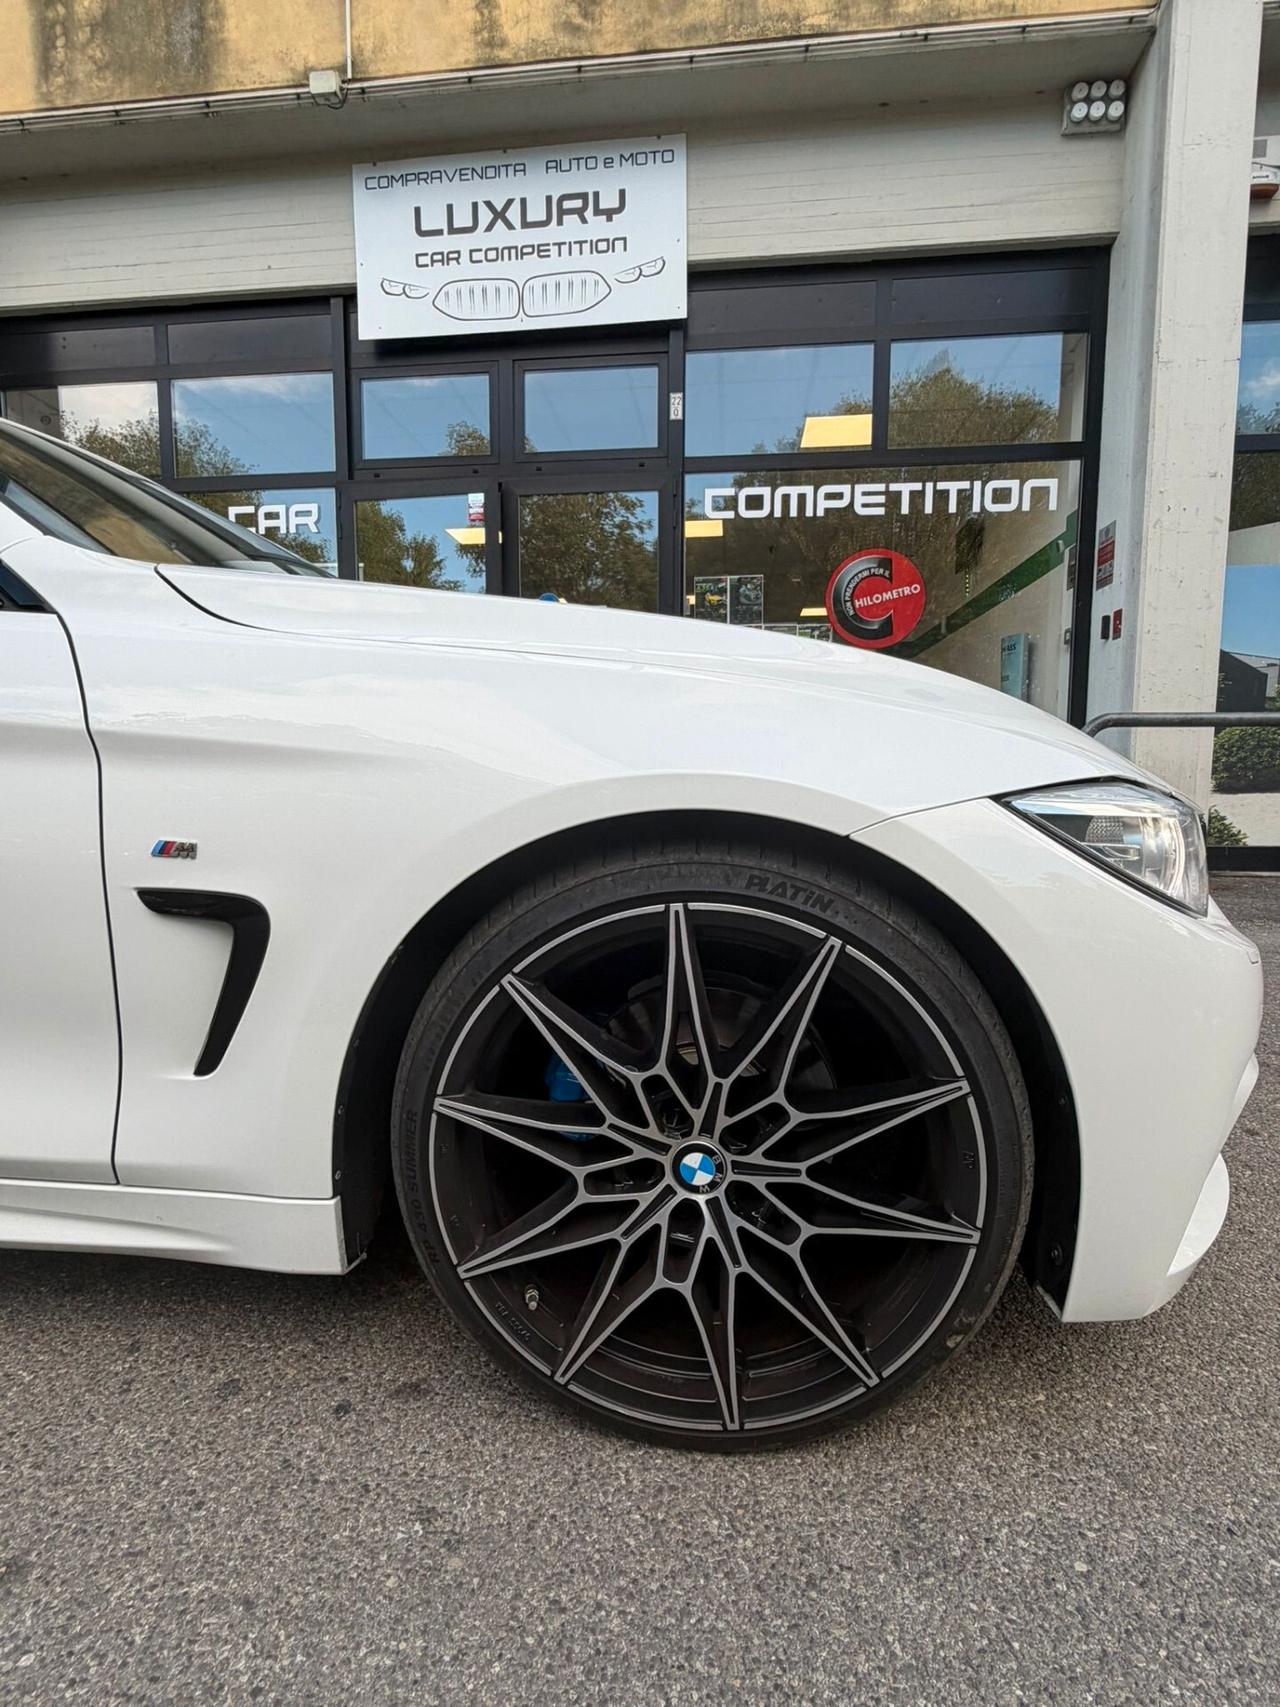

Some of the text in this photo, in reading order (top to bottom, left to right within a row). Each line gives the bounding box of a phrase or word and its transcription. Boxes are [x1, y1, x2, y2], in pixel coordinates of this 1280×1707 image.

[364, 162, 527, 190] COMPRAVENDITA
[545, 155, 598, 174] AUTO
[619, 149, 675, 168] MOTO
[413, 188, 627, 238] LUXURY
[415, 236, 628, 268] CAR COMPETITION
[704, 478, 1059, 519] COMPETITION
[870, 567, 884, 576] PER
